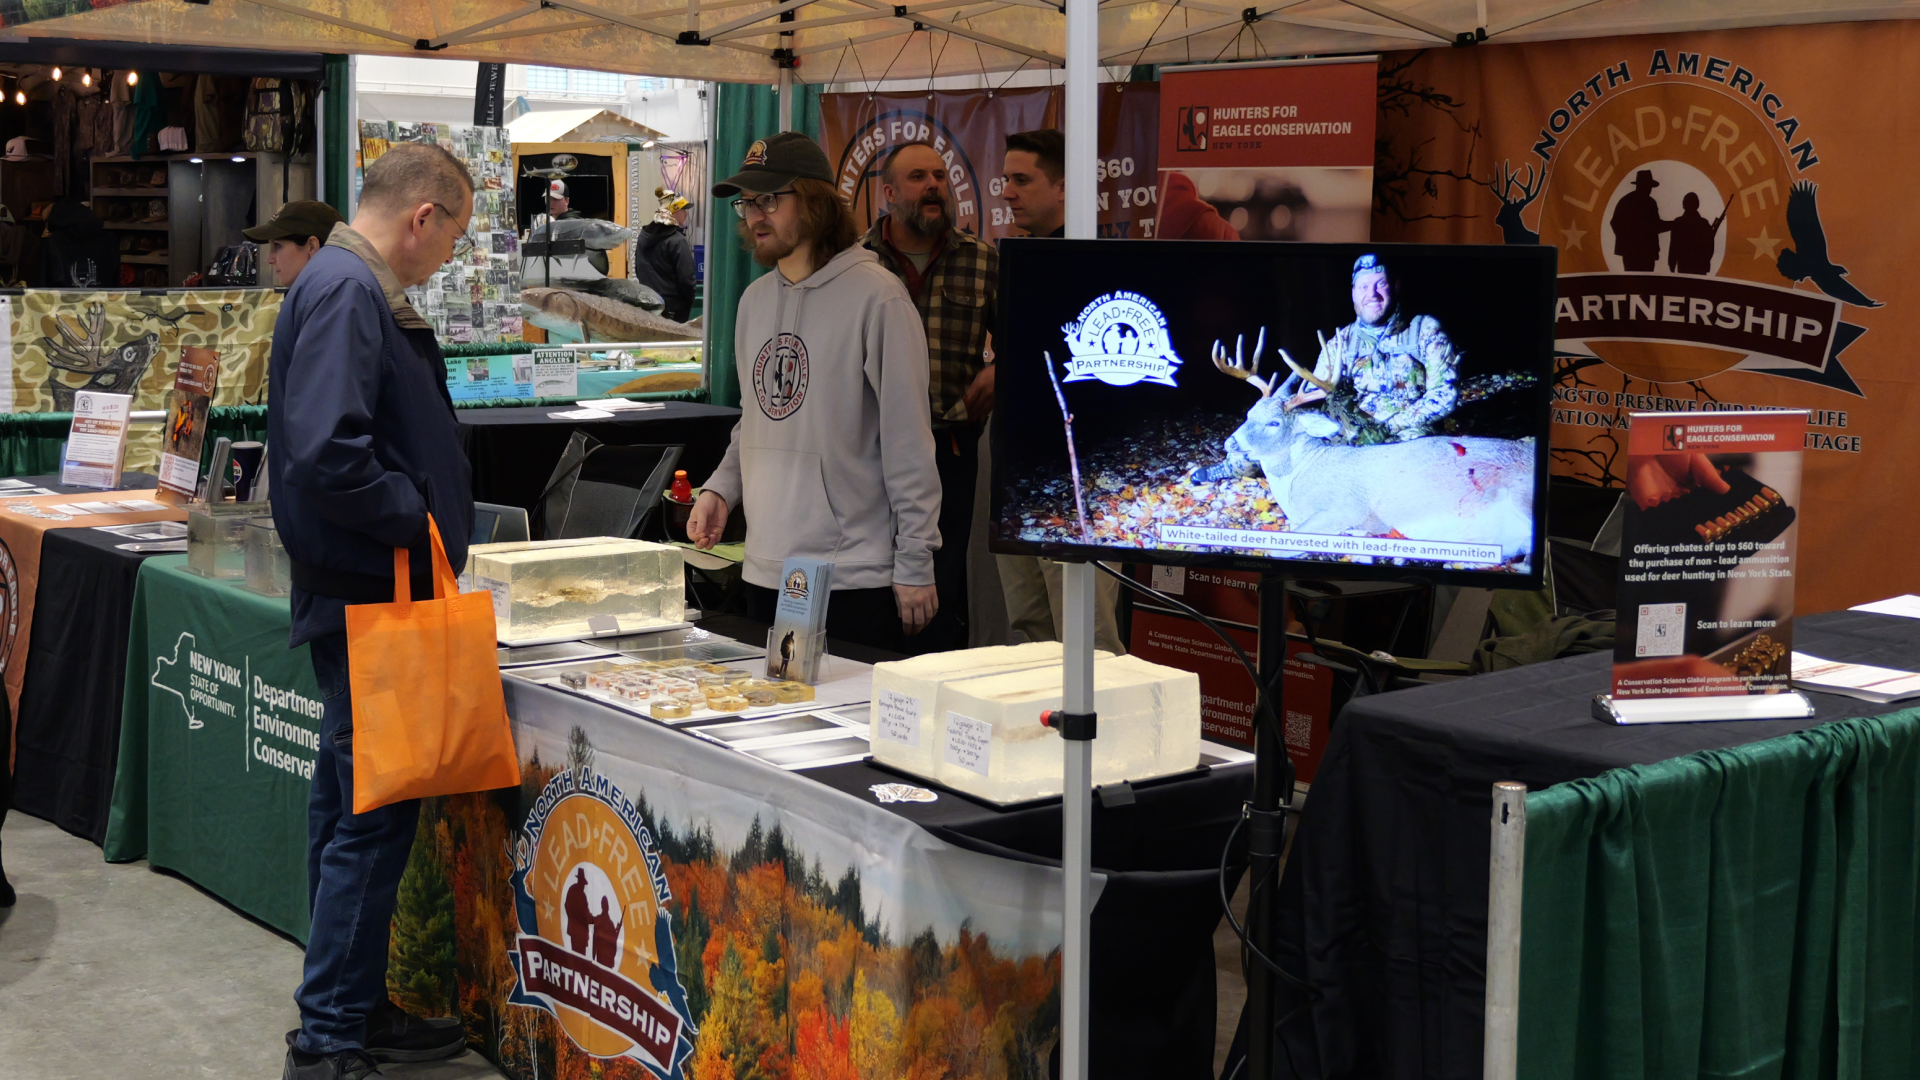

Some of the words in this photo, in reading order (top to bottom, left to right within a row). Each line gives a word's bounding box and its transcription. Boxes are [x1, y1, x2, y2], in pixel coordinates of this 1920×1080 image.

[490, 63, 499, 92] JEWE
[486, 94, 495, 127] ULLET
[1213, 107, 1270, 120] HUNTERS
[1272, 106, 1298, 119] FOR
[1531, 60, 1633, 162] NORTH
[1648, 49, 1820, 173] AMERICAN
[1212, 124, 1251, 137] EAGLE
[1253, 122, 1351, 136] CONSERVATION
[1236, 141, 1262, 149] YORK
[891, 121, 930, 142] FOR
[933, 135, 974, 217] EAGLE
[1097, 157, 1134, 182] $60
[1077, 293, 1111, 323] NORTH
[1114, 290, 1167, 327] AMERICAN
[1554, 294, 1823, 343] ARTNERSHIP
[798, 347, 807, 380] EAGLE
[1076, 359, 1165, 372] PARTNERSHIP
[1584, 389, 1610, 406] TO
[1614, 392, 1697, 412] PRESERVE
[1687, 425, 1724, 433] HUNTERS
[1687, 435, 1712, 443] EAGLE
[1713, 434, 1775, 442] CONSERVATION
[1167, 529, 1237, 543] White-tailed
[1241, 533, 1267, 544] deer
[1270, 535, 1329, 548] harvested
[1333, 539, 1358, 550] with
[1363, 541, 1416, 553] lead-free
[1420, 545, 1496, 559] ammunition
[1634, 544, 1670, 555] Offering
[1671, 543, 1702, 553] rebates
[1704, 542, 1714, 552] of
[1715, 543, 1726, 553] up
[1727, 542, 1737, 551] to
[1737, 541, 1753, 551] $60
[1755, 541, 1785, 550] toward
[1234, 561, 1273, 569] INSIGNIA
[1628, 558, 1644, 568] the
[1645, 557, 1683, 569] purchase
[1685, 557, 1695, 566] of
[1695, 558, 1712, 566] non
[1719, 555, 1737, 565] lead
[1738, 555, 1789, 564] ammunition
[1189, 571, 1210, 583] Scan
[1212, 575, 1221, 584] to
[1223, 576, 1246, 589] learn
[1624, 571, 1646, 581] used
[1648, 571, 1660, 581] for
[1661, 571, 1680, 580] deer
[1682, 569, 1715, 581] hunting
[1717, 570, 1726, 579] in
[1727, 569, 1746, 578] New
[1748, 568, 1767, 578] York
[1768, 568, 1792, 577] State.
[7, 566, 17, 636] EAGLE
[1696, 620, 1718, 630] Scan
[1719, 620, 1728, 629] to
[1729, 619, 1753, 628] learn
[1753, 620, 1777, 628] more
[1148, 639, 1160, 647] New
[1161, 642, 1173, 651] York
[1175, 645, 1189, 654] State
[1190, 648, 1223, 660] Department
[1154, 632, 1190, 644] Conservation
[1191, 639, 1213, 649] Science
[1214, 644, 1233, 653] Global
[1303, 662, 1316, 670] with
[190, 651, 214, 674] NEW
[213, 659, 242, 688] YORK
[1623, 678, 1662, 686] Conservation
[1662, 677, 1686, 685] Science
[1686, 676, 1706, 684] Global
[1706, 677, 1731, 685] program
[1739, 674, 1774, 683] partnership
[190, 673, 209, 691] STATE
[210, 683, 219, 696] OF
[1661, 686, 1697, 695] Department
[1705, 684, 1747, 692] Environmental
[1748, 683, 1788, 692] Conservation.
[254, 675, 325, 720] Departmen
[1201, 694, 1244, 711] partment
[1245, 703, 1255, 714] of
[254, 705, 320, 751] Environme
[1201, 706, 1252, 727] vironmenta
[1201, 720, 1246, 739] nservation
[254, 736, 316, 781] Conservat
[524, 766, 575, 841] NORTH
[580, 765, 673, 904] AMERICAN
[526, 950, 672, 1046] PARTNERSHIP
